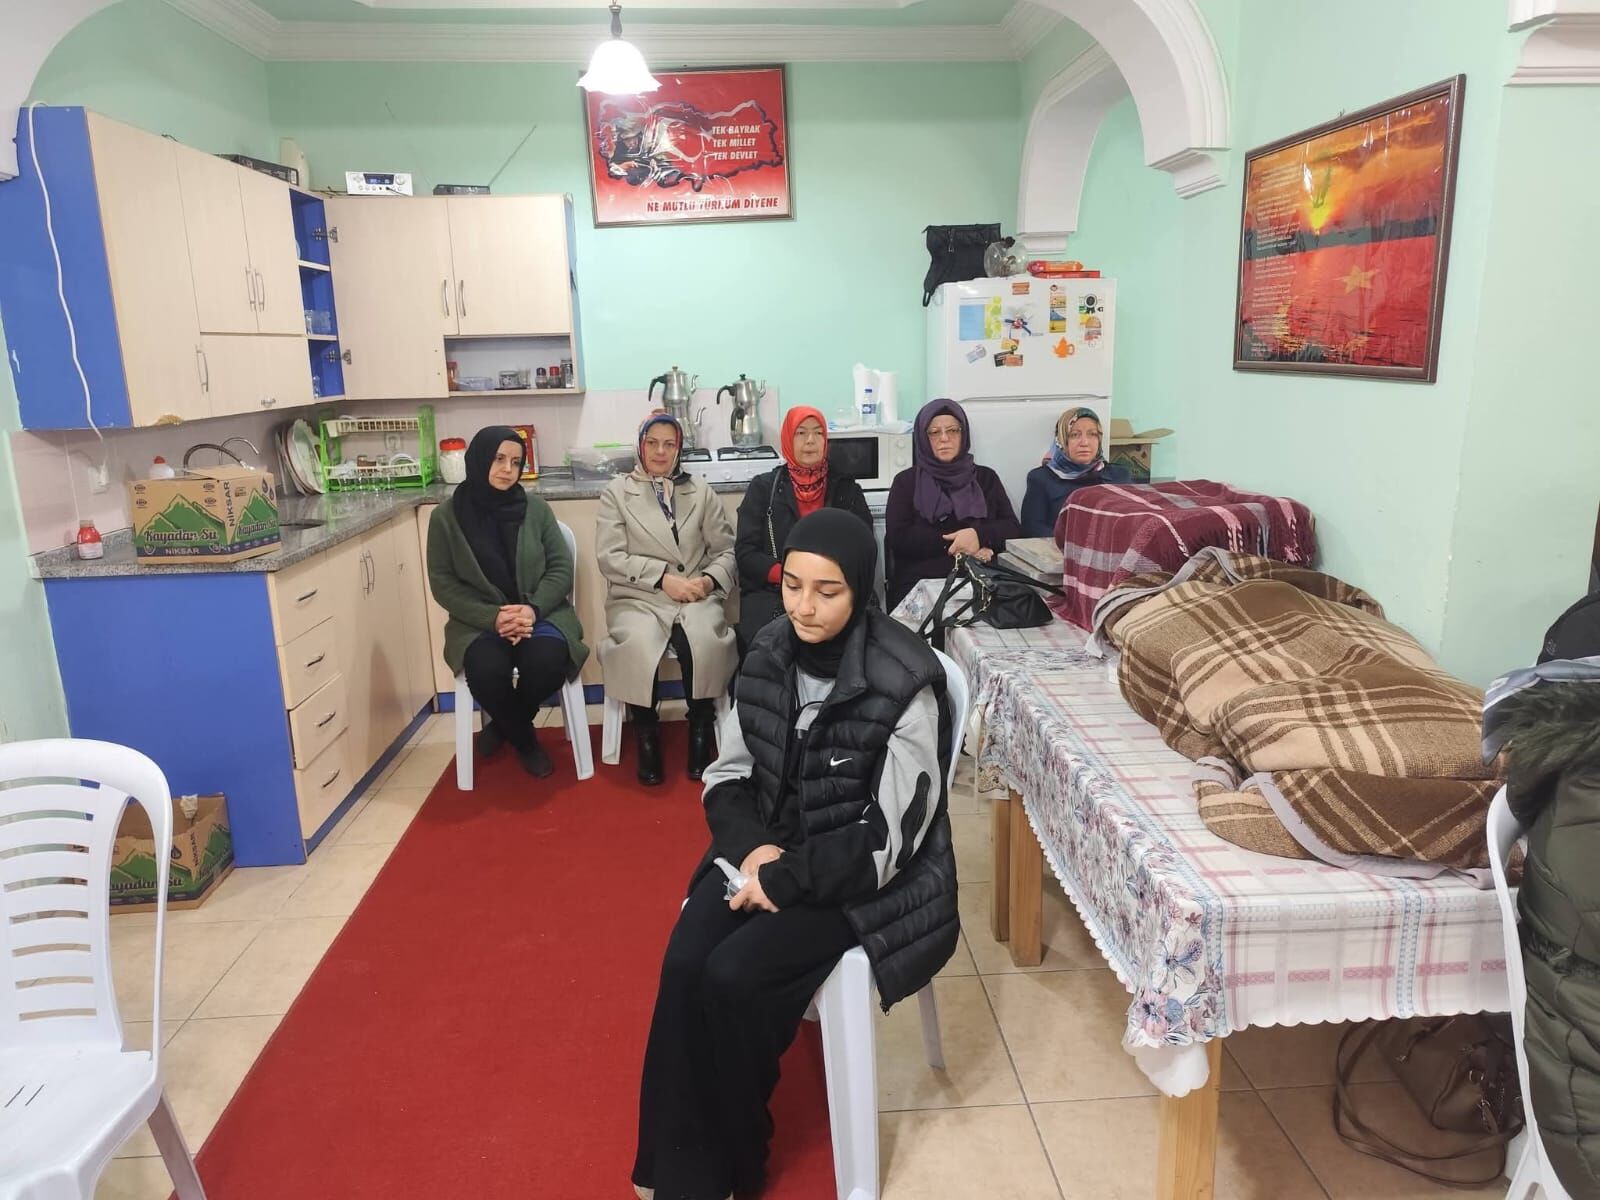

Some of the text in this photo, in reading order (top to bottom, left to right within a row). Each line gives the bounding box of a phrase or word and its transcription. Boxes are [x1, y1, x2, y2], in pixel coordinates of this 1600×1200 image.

[712, 125, 760, 134] TEK BAYRAK
[713, 139, 727, 147] TEK
[714, 151, 758, 160] TEK DEVLET
[647, 202, 659, 212] NE
[744, 195, 779, 208] DİYENE
[201, 529, 217, 540] Su
